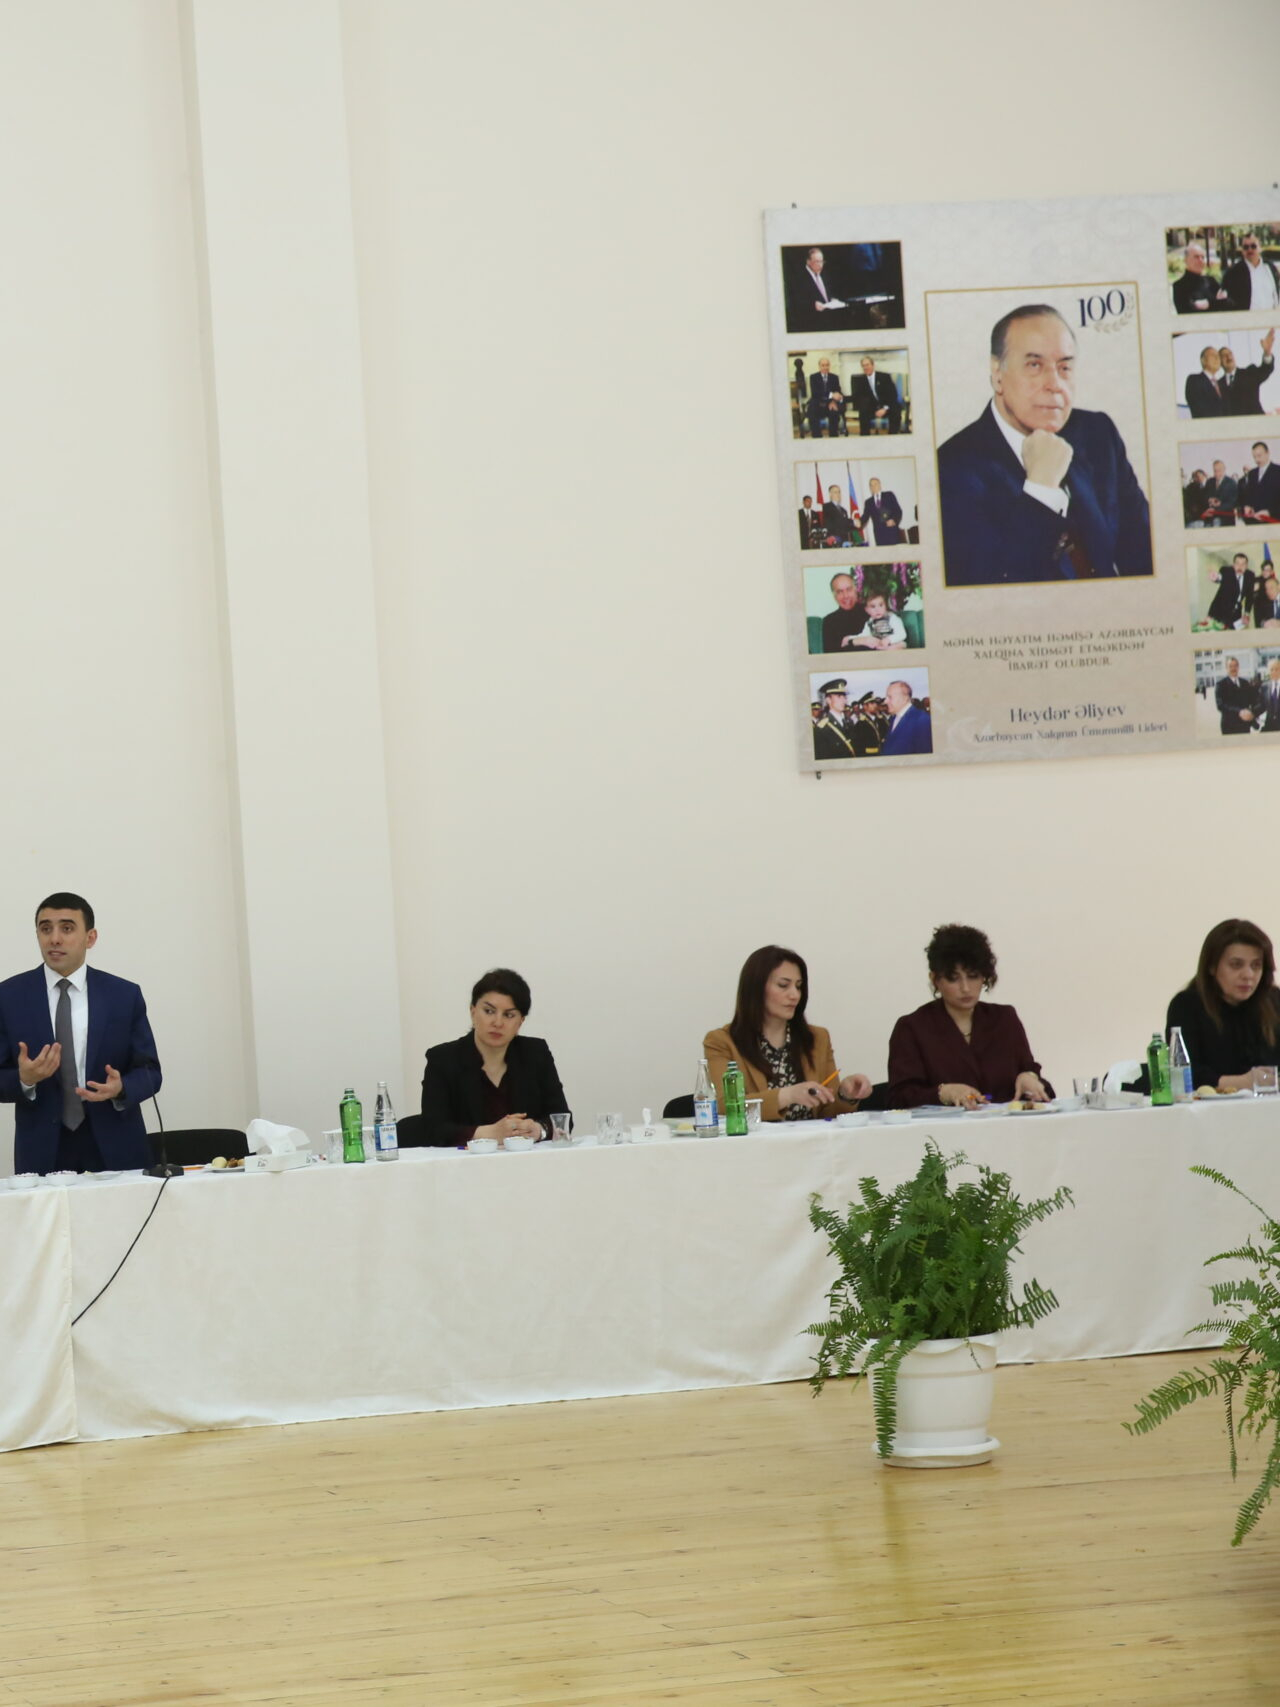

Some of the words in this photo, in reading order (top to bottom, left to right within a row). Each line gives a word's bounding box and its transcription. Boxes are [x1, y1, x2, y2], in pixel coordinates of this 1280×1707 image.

[1077, 288, 1125, 328] 100
[942, 635, 984, 648] MƏNİM
[989, 633, 1042, 645] HƏYATIM
[1047, 631, 1093, 642] HƏMİŞƏ
[1099, 625, 1174, 640] AZƏRBAYCAN
[974, 648, 1024, 661] XALQINA
[1029, 644, 1072, 657] XİDMƏT
[1080, 641, 1144, 653] ETMƏKDƏN
[1008, 659, 1048, 671] İBARƏT
[1010, 705, 1070, 725] Heydər
[1074, 703, 1126, 721] Əliyev
[973, 732, 1033, 743] Azərbaycan
